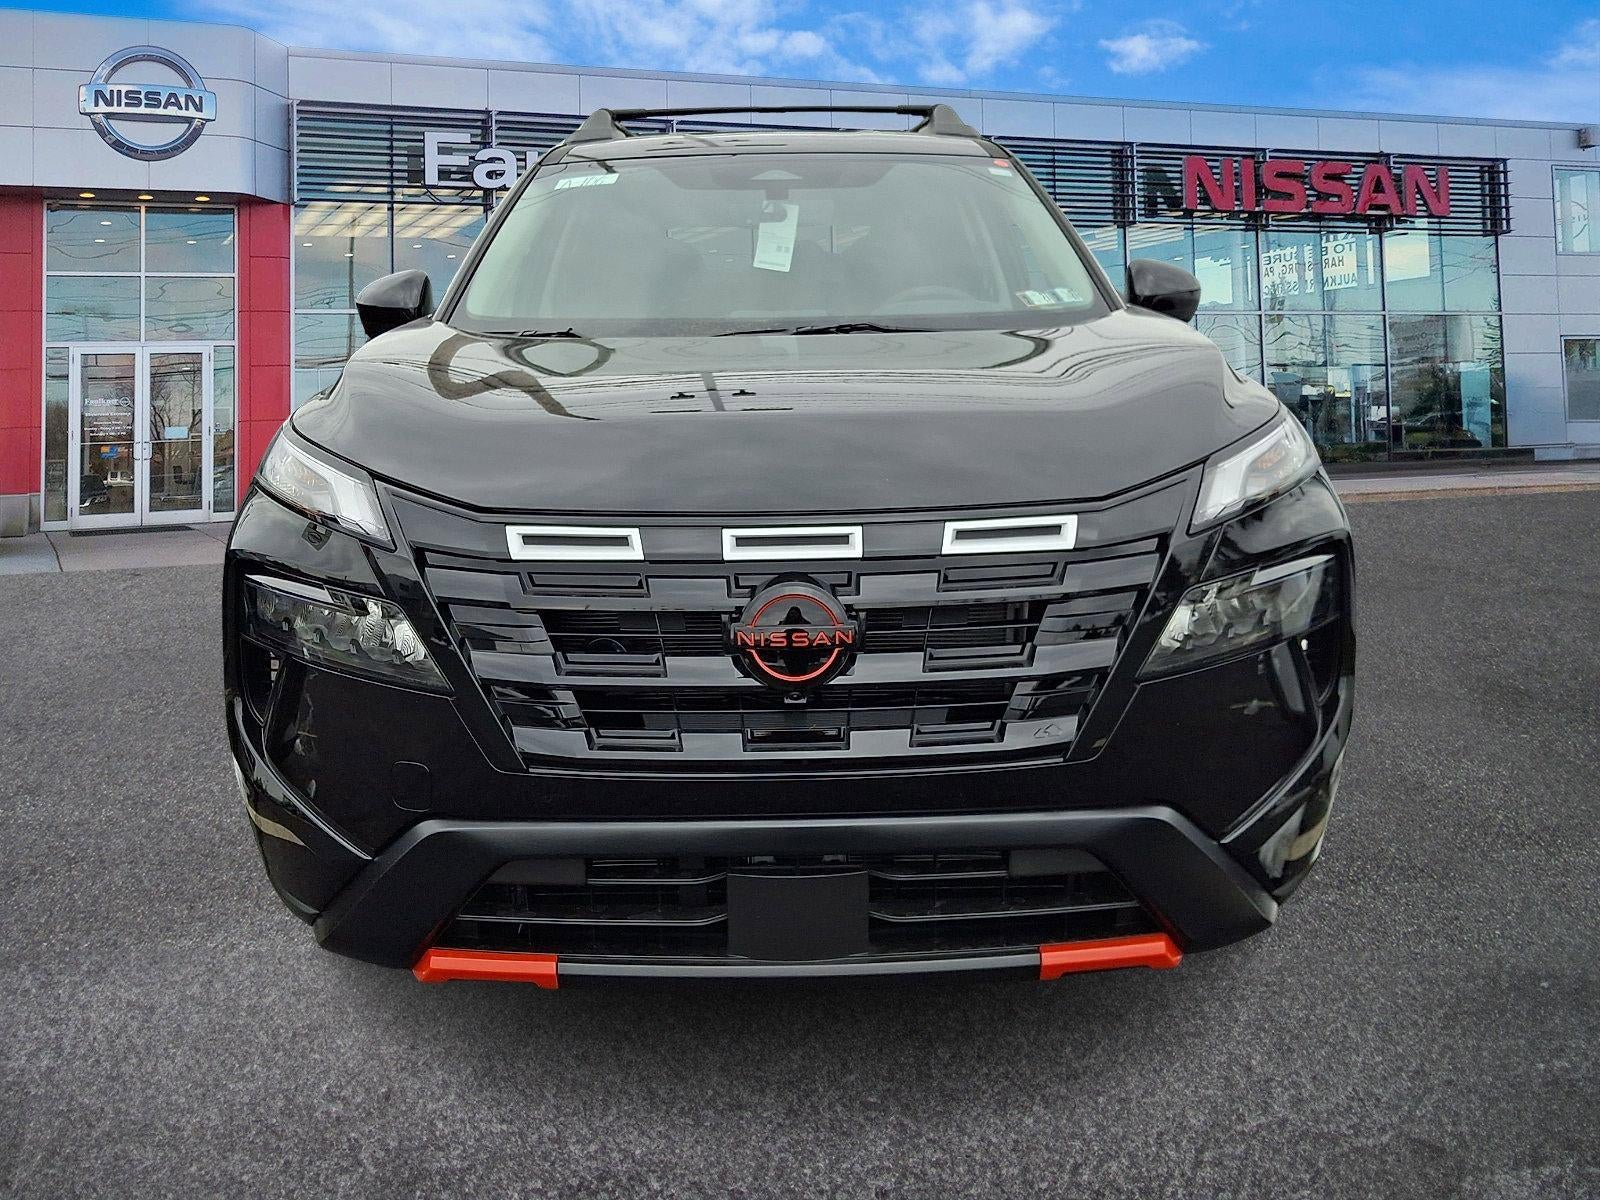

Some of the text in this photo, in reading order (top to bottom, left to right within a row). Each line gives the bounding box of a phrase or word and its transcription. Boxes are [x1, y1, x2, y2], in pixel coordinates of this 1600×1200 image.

[94, 90, 203, 113] NISSAN
[1183, 155, 1450, 216] NISSAN
[736, 630, 854, 647] NISSAN
